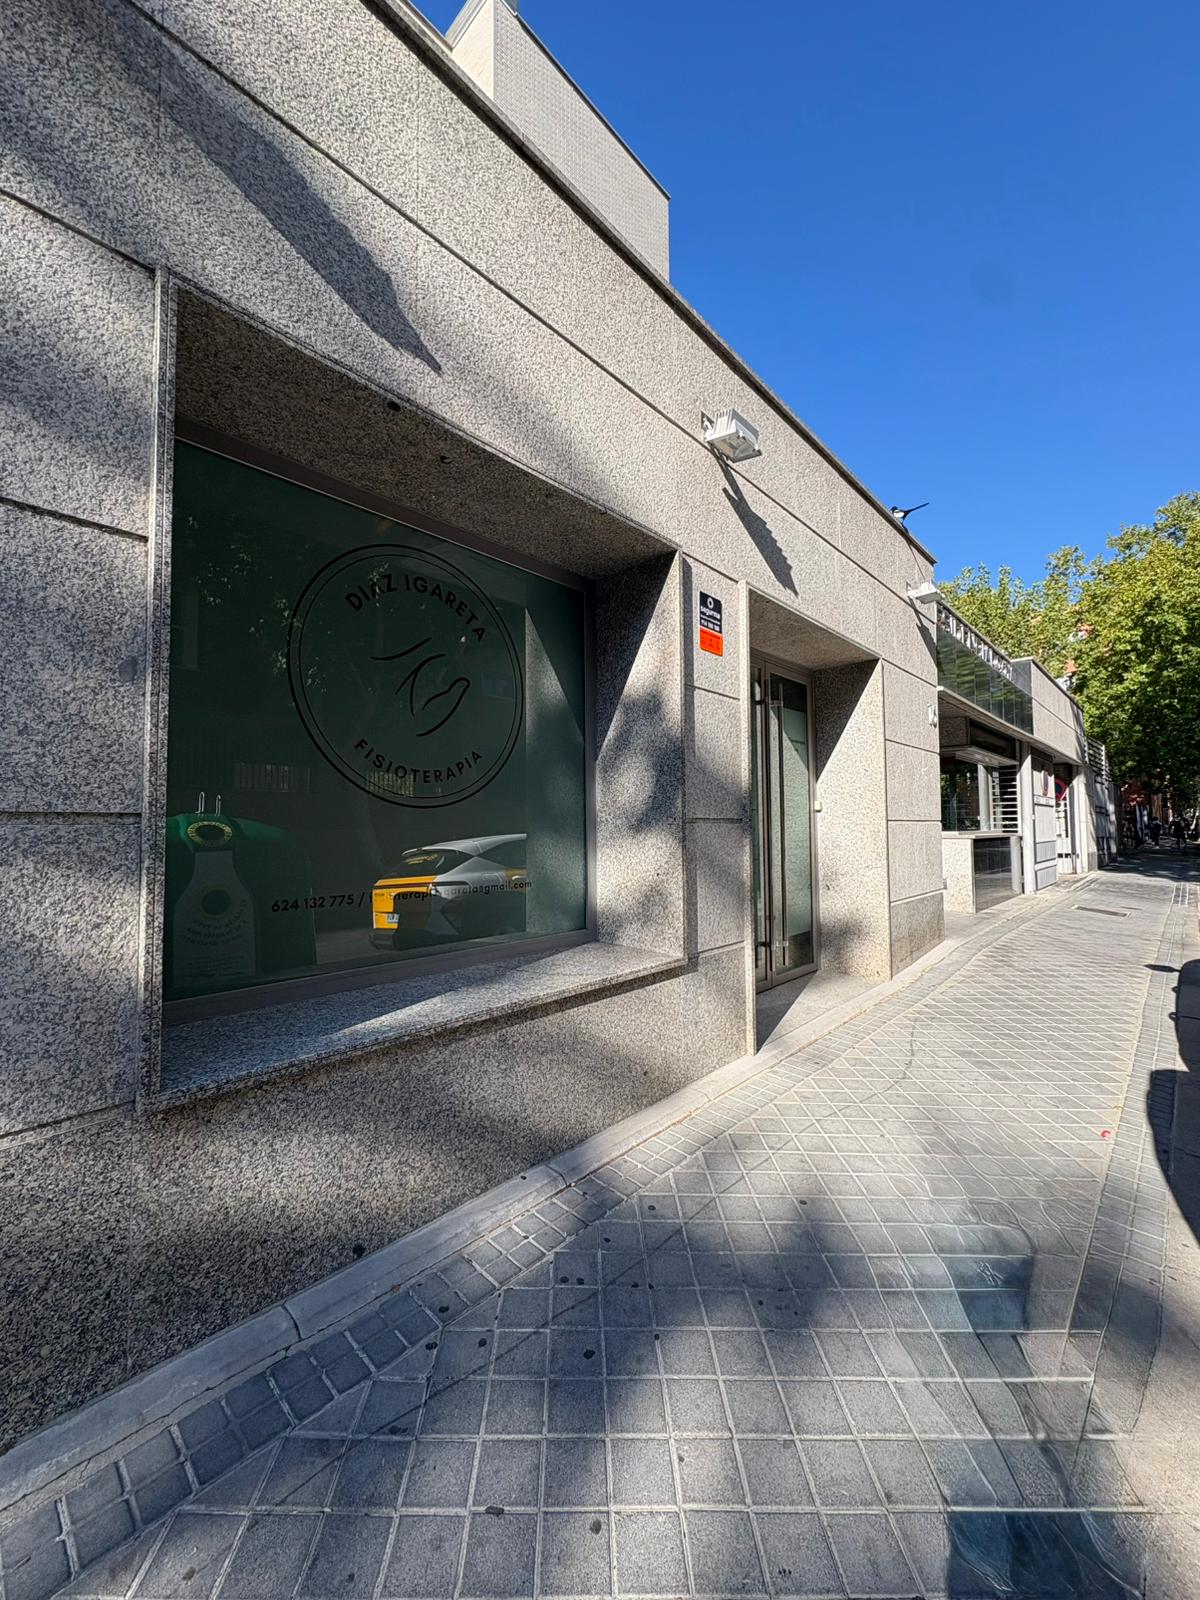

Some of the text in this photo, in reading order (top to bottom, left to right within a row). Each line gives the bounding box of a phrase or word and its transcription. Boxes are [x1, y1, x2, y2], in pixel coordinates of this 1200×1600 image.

[344, 573, 487, 641] DIAZ IGARETA
[354, 738, 483, 784] FISIOTERAPIA
[271, 899, 299, 912] 624
[304, 896, 325, 909] 132
[329, 893, 354, 907] 775
